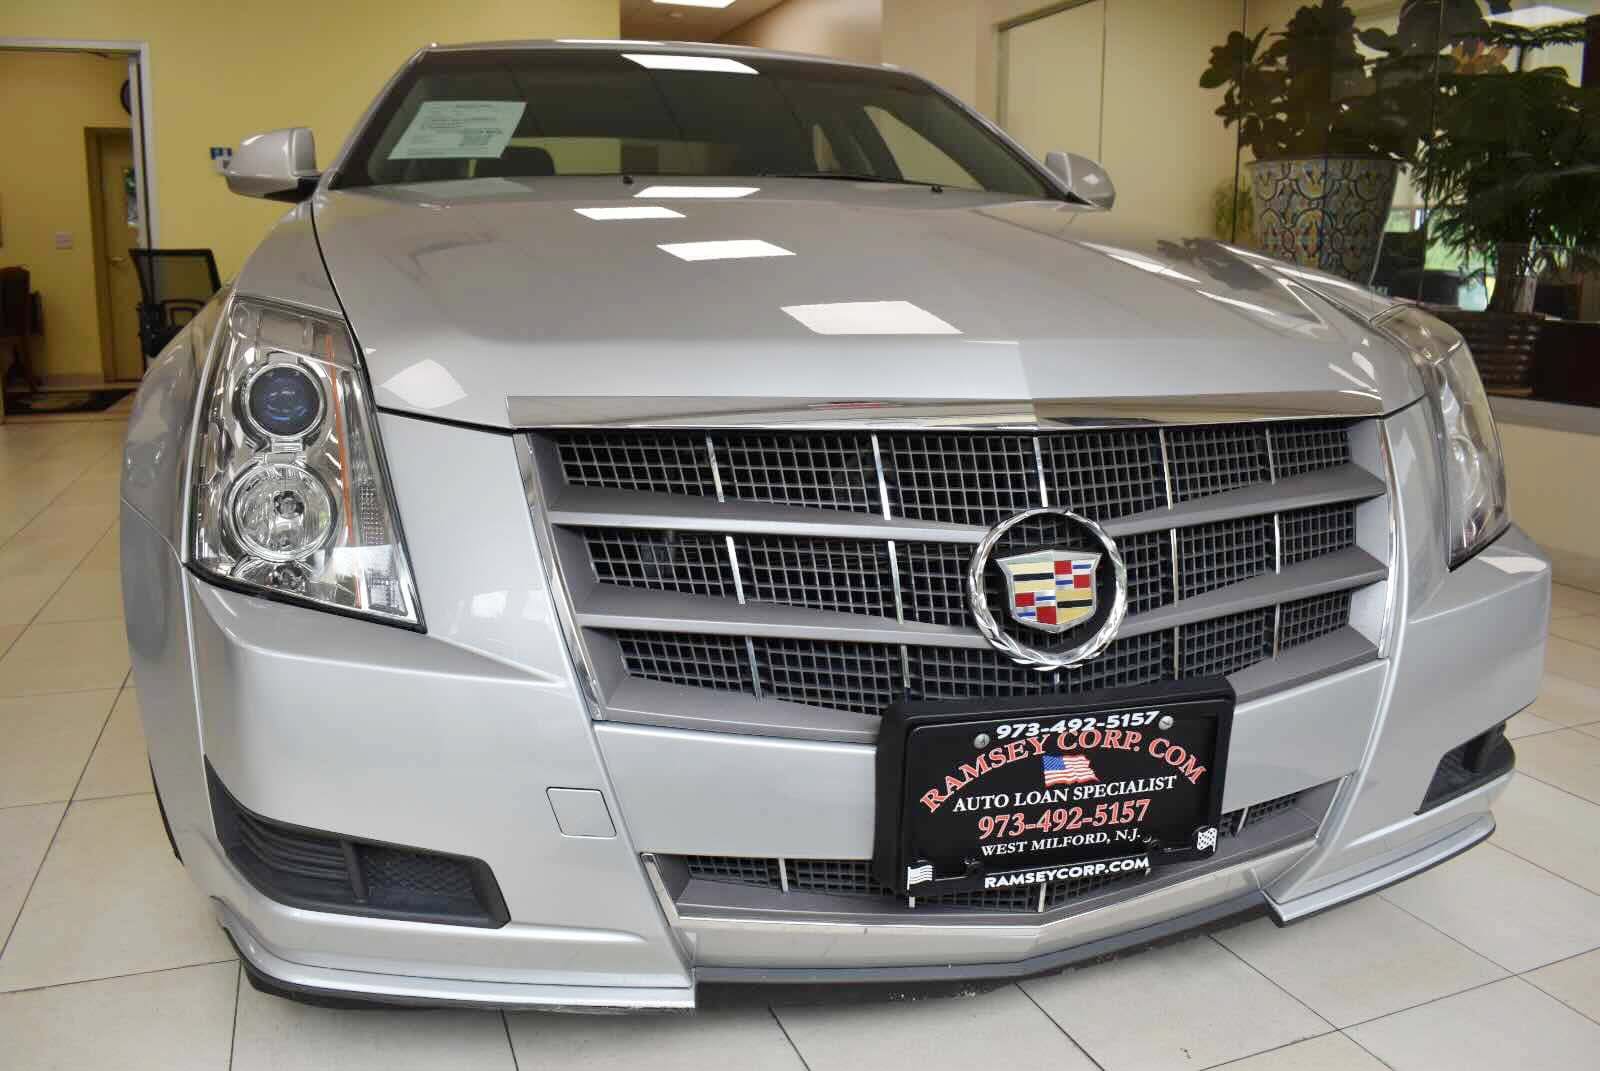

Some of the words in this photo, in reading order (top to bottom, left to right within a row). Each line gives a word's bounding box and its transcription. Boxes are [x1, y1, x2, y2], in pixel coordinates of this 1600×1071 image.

[996, 710, 1160, 739] 973-492-5157
[920, 733, 1051, 814] RAMSEY
[1148, 737, 1207, 785] COM
[952, 793, 1009, 813] AUTO
[1014, 787, 1069, 807] LOAN
[1073, 775, 1178, 802] SPECIALIST
[978, 799, 1152, 840] 973-492-5157
[982, 841, 1028, 857] WEST
[1032, 831, 1111, 852] MILFORD,
[1115, 829, 1141, 842] N.J.
[984, 856, 1150, 889] RAMSEYCORP.COM
